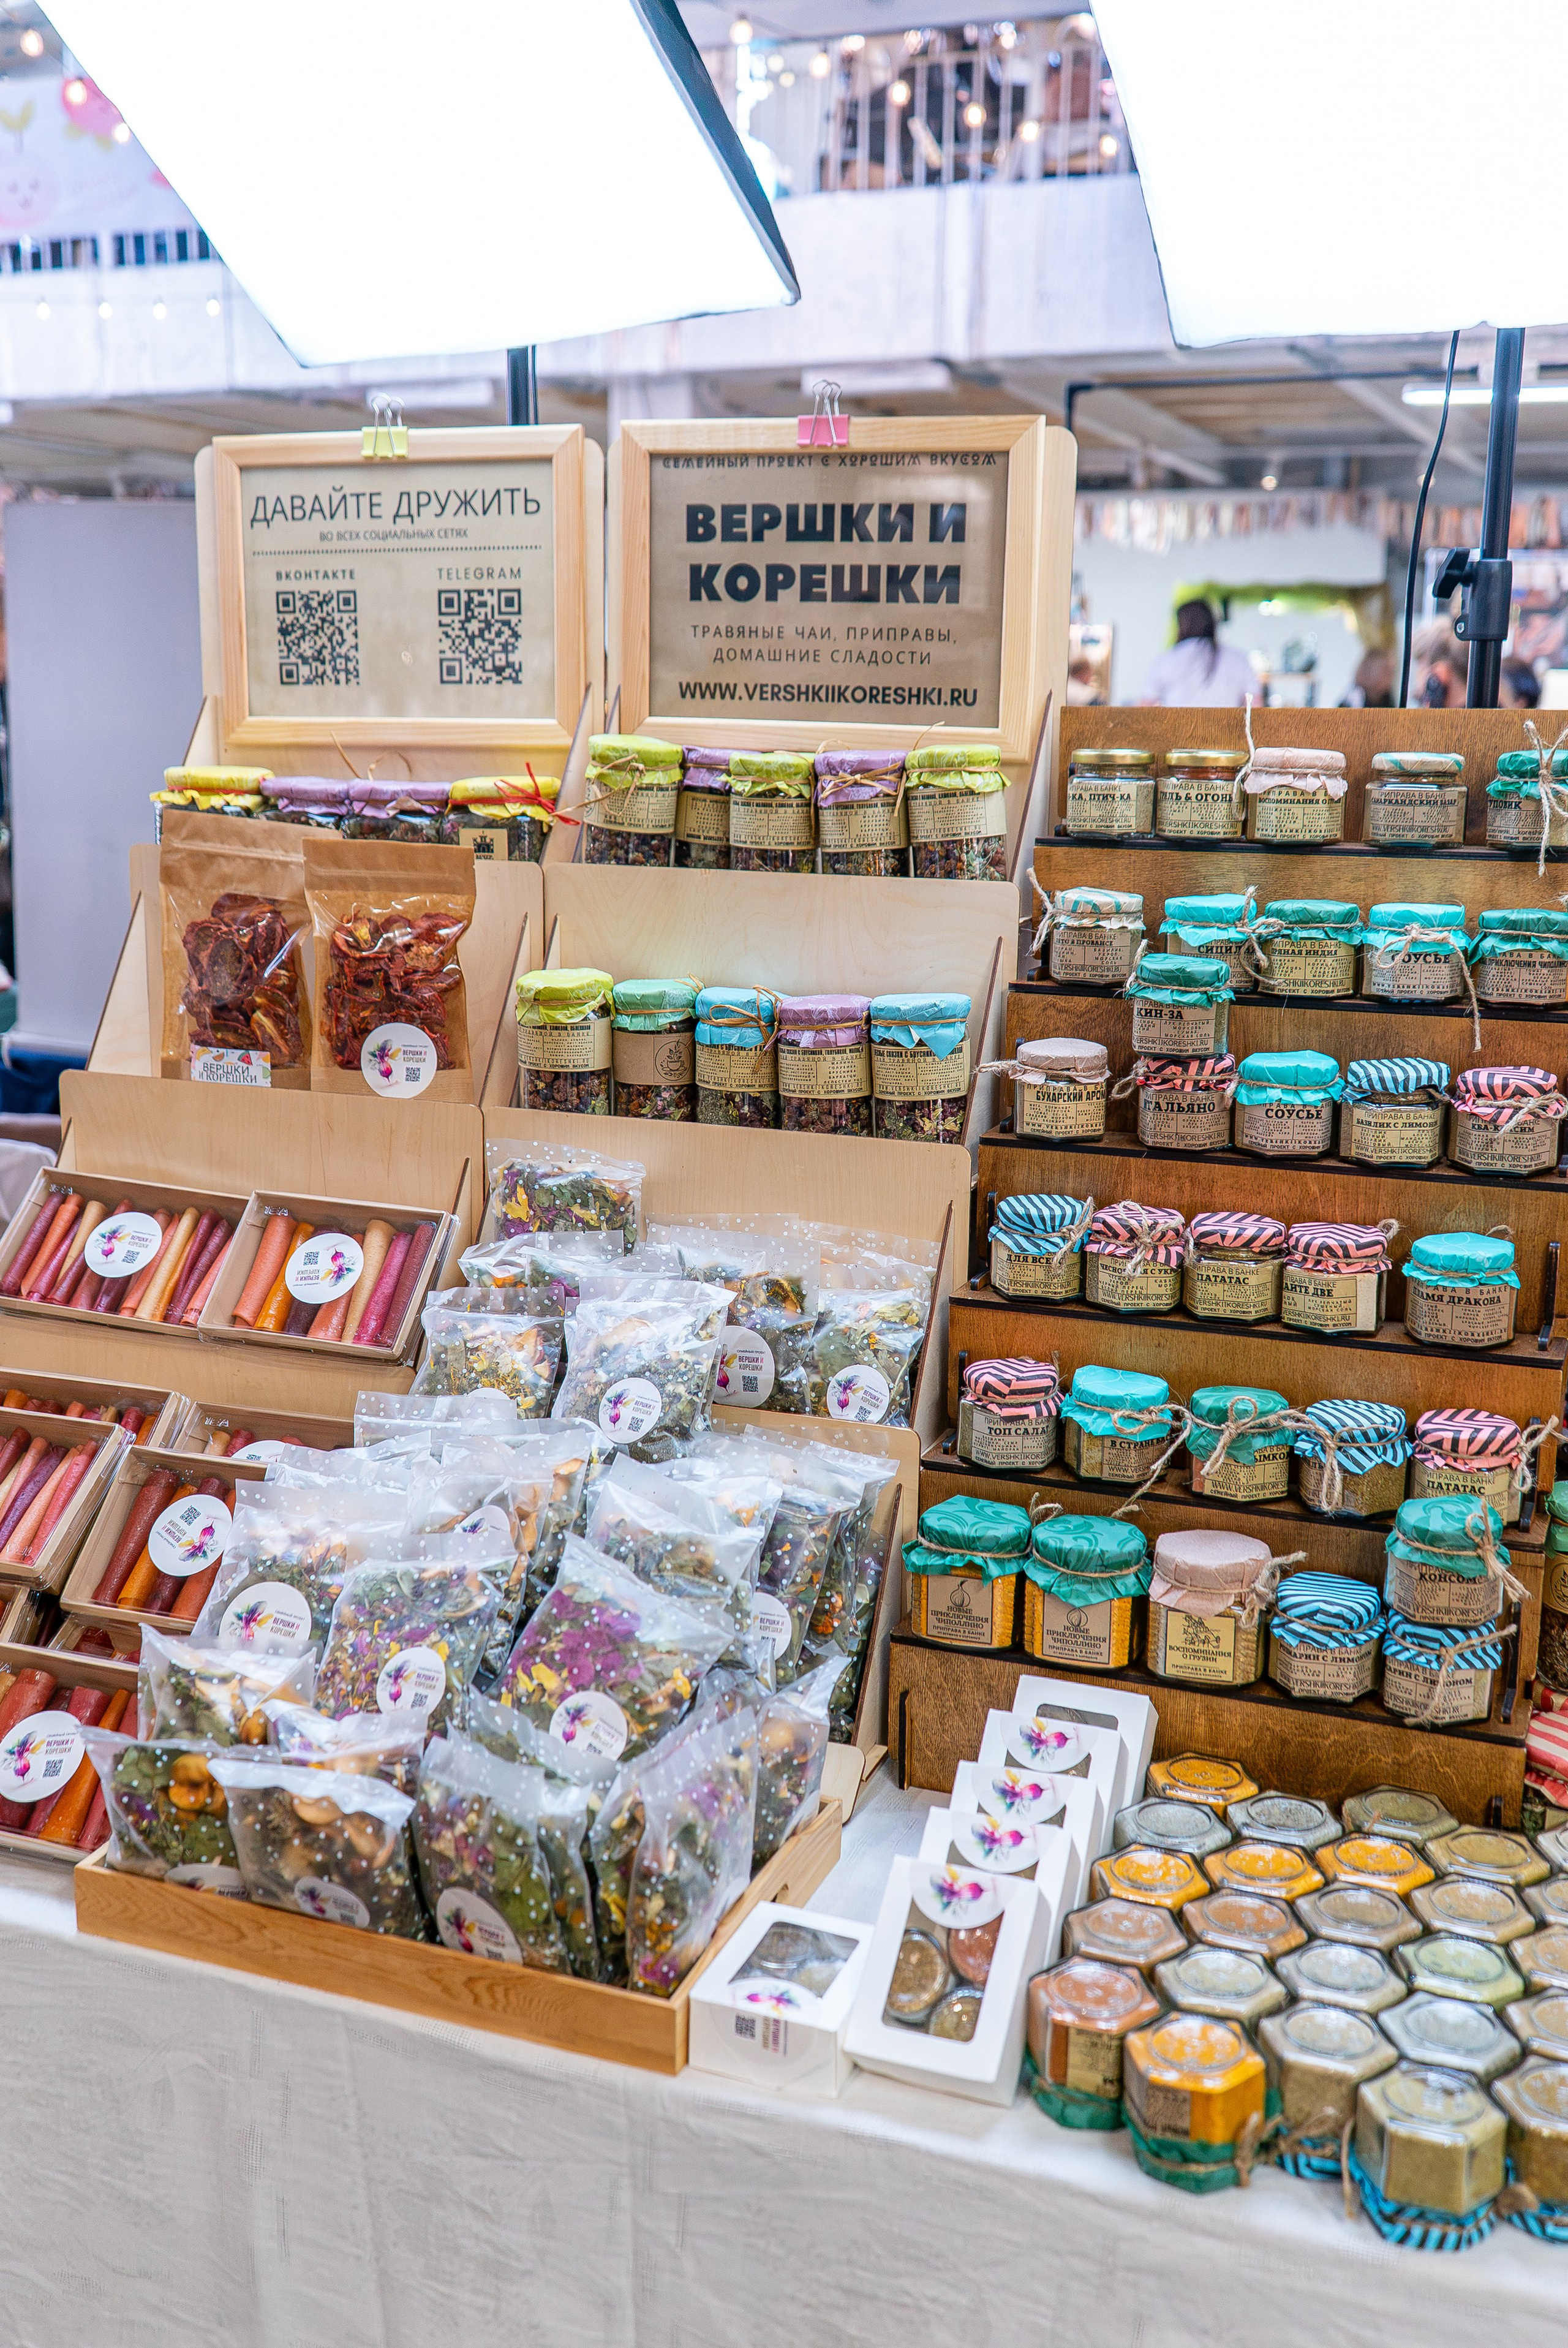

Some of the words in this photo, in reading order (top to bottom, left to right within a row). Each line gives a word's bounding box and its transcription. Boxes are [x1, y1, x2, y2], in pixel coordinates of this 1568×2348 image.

[663, 455, 749, 468] СЕМЕЙНЫЙ
[758, 455, 814, 467] ПРОЕКТ
[822, 456, 830, 466] С
[839, 454, 920, 466] ХОРОШИМ
[930, 453, 997, 466] ВКУСОМ
[251, 486, 383, 529] ДАВАЙТЕ
[394, 488, 541, 524] ДРУЖИТЬ
[686, 504, 914, 542] ВЕРШКИ
[930, 504, 967, 542] И
[319, 531, 333, 542] ВО
[337, 530, 360, 540] ВСЕХ
[363, 529, 434, 540] СОЦИАЛЬНЫХ
[437, 528, 468, 538] СЕТЯХ
[276, 570, 355, 581] ВКОНТАКТЕ
[437, 567, 521, 580] TELEGRAM
[689, 563, 960, 603] КОРЕШКИ
[692, 624, 784, 638] ТРАВЯНЫЕ
[796, 626, 835, 641] ЧАИ,
[846, 627, 957, 643] ПРИПРАВЫ,
[713, 647, 821, 663] ДОМАШНИЕ
[831, 649, 930, 666] СЛАДОСТИ
[679, 681, 978, 706] WWW.VERSHKIIKORESHKI.RU
[1136, 1008, 1183, 1019] КИН-ЗА
[203, 1062, 249, 1076] ВЕРШКИ
[206, 1071, 257, 1083] КОРЕШКИ
[1036, 1090, 1083, 1103] БУХАРСКИЙ
[1190, 1094, 1215, 1103] БАНКЕ
[1265, 1108, 1323, 1120] СОУСЬЕ
[1356, 1119, 1391, 1128] БАЗИЛИК
[1007, 1254, 1028, 1263] ДЛЯ
[1197, 1272, 1249, 1285] ПАТАТАС
[1314, 1278, 1336, 1288] БАНКЕ
[1312, 1288, 1333, 1297] ДВЕ
[1480, 1285, 1507, 1296] БАНКЕ
[1447, 1295, 1501, 1307] ДРАКОНА
[635, 1400, 652, 1409] ВЕРШКИ
[988, 1426, 1011, 1435] ТОП
[1427, 1481, 1485, 1494] ПАТАТАС
[167, 1519, 187, 1537] КОРЕШКИ
[165, 1527, 182, 1543] ВЕРШКИ
[931, 1610, 989, 1623] ПРИКЛЮЧЕНИЯ
[947, 1606, 972, 1615] НОВЫЕ
[273, 1617, 295, 1629] ВЕРШКИ
[760, 1625, 782, 1633] КОРЕШКИ
[935, 1617, 984, 1629] ЧИПОЛЛИНО
[270, 1626, 296, 1639] КОРЕШКИ
[1063, 1625, 1090, 1634] НОВЫЕ
[1047, 1629, 1106, 1643] ПРИКЛЮЧЕНИЯ
[1052, 1636, 1101, 1648] ЧИПОЛЛИНО
[1169, 1645, 1231, 1658] ВОСПОМИНАНИЯ
